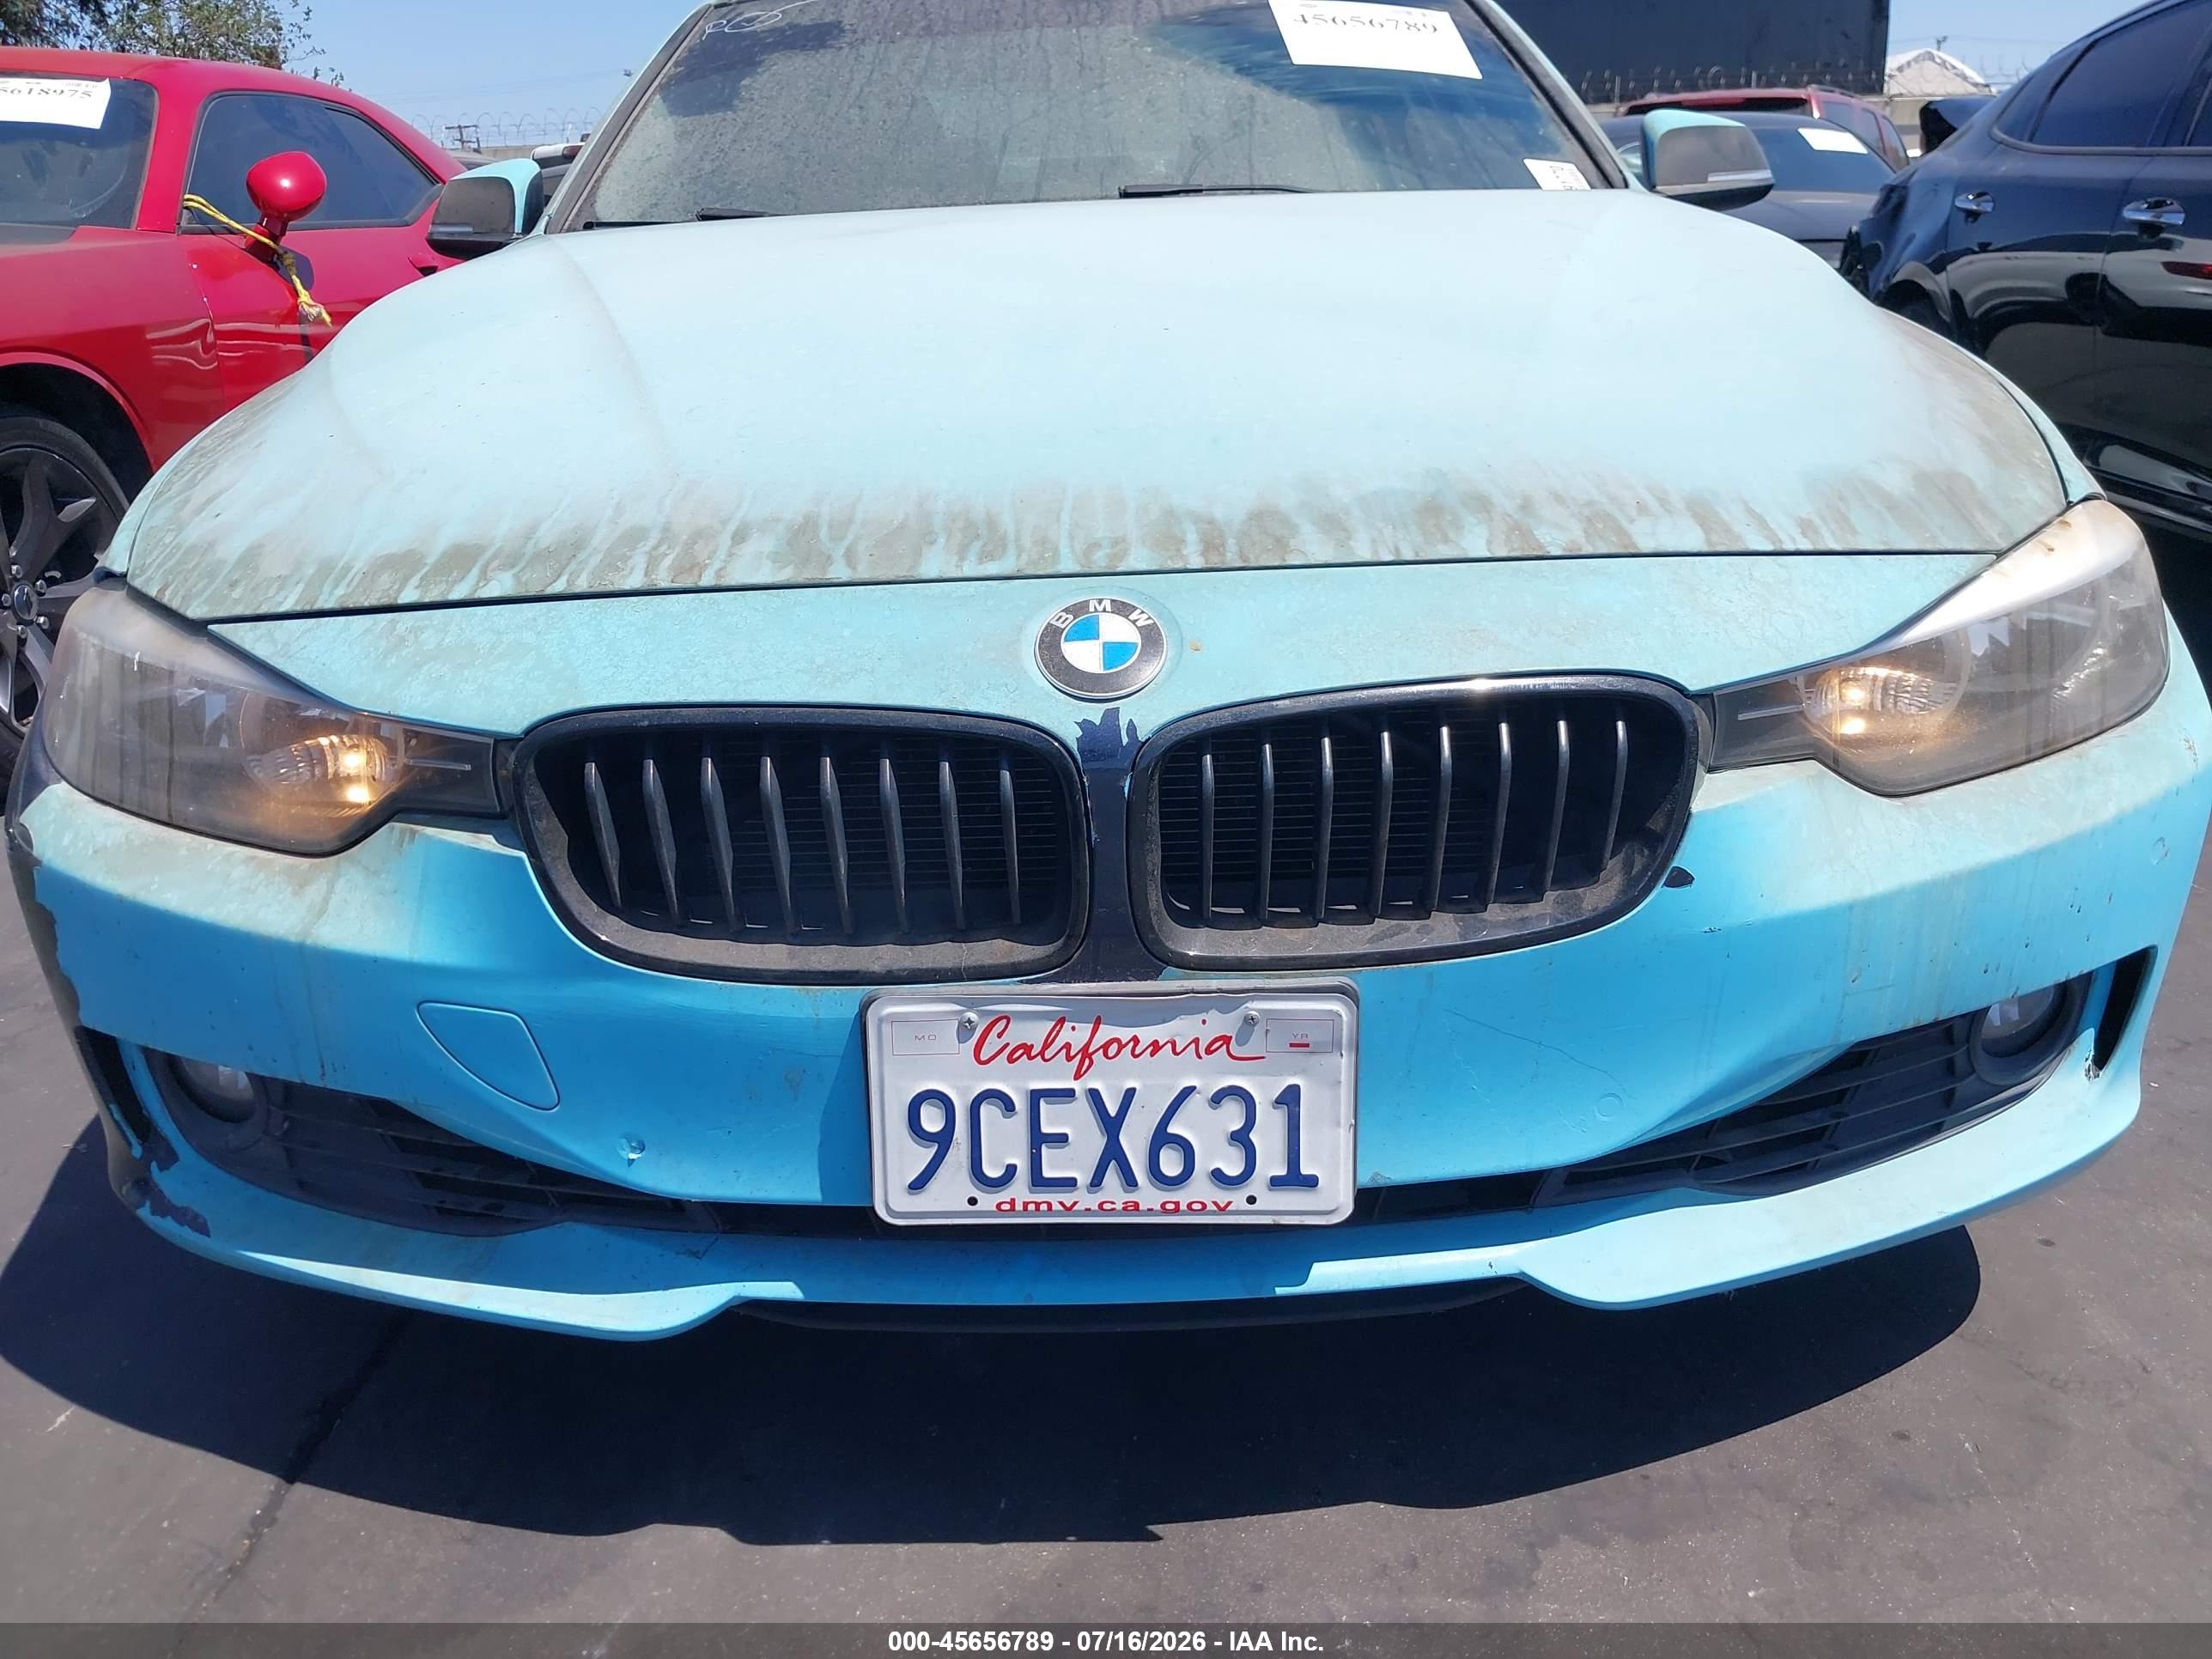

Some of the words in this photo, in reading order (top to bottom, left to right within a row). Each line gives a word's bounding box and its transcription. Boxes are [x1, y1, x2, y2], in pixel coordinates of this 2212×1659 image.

[1049, 599, 1154, 629] BMW
[973, 1015, 1266, 1081] California
[907, 1085, 1320, 1191] 9CEX631
[995, 1198, 1234, 1213] dmv.ca.gov
